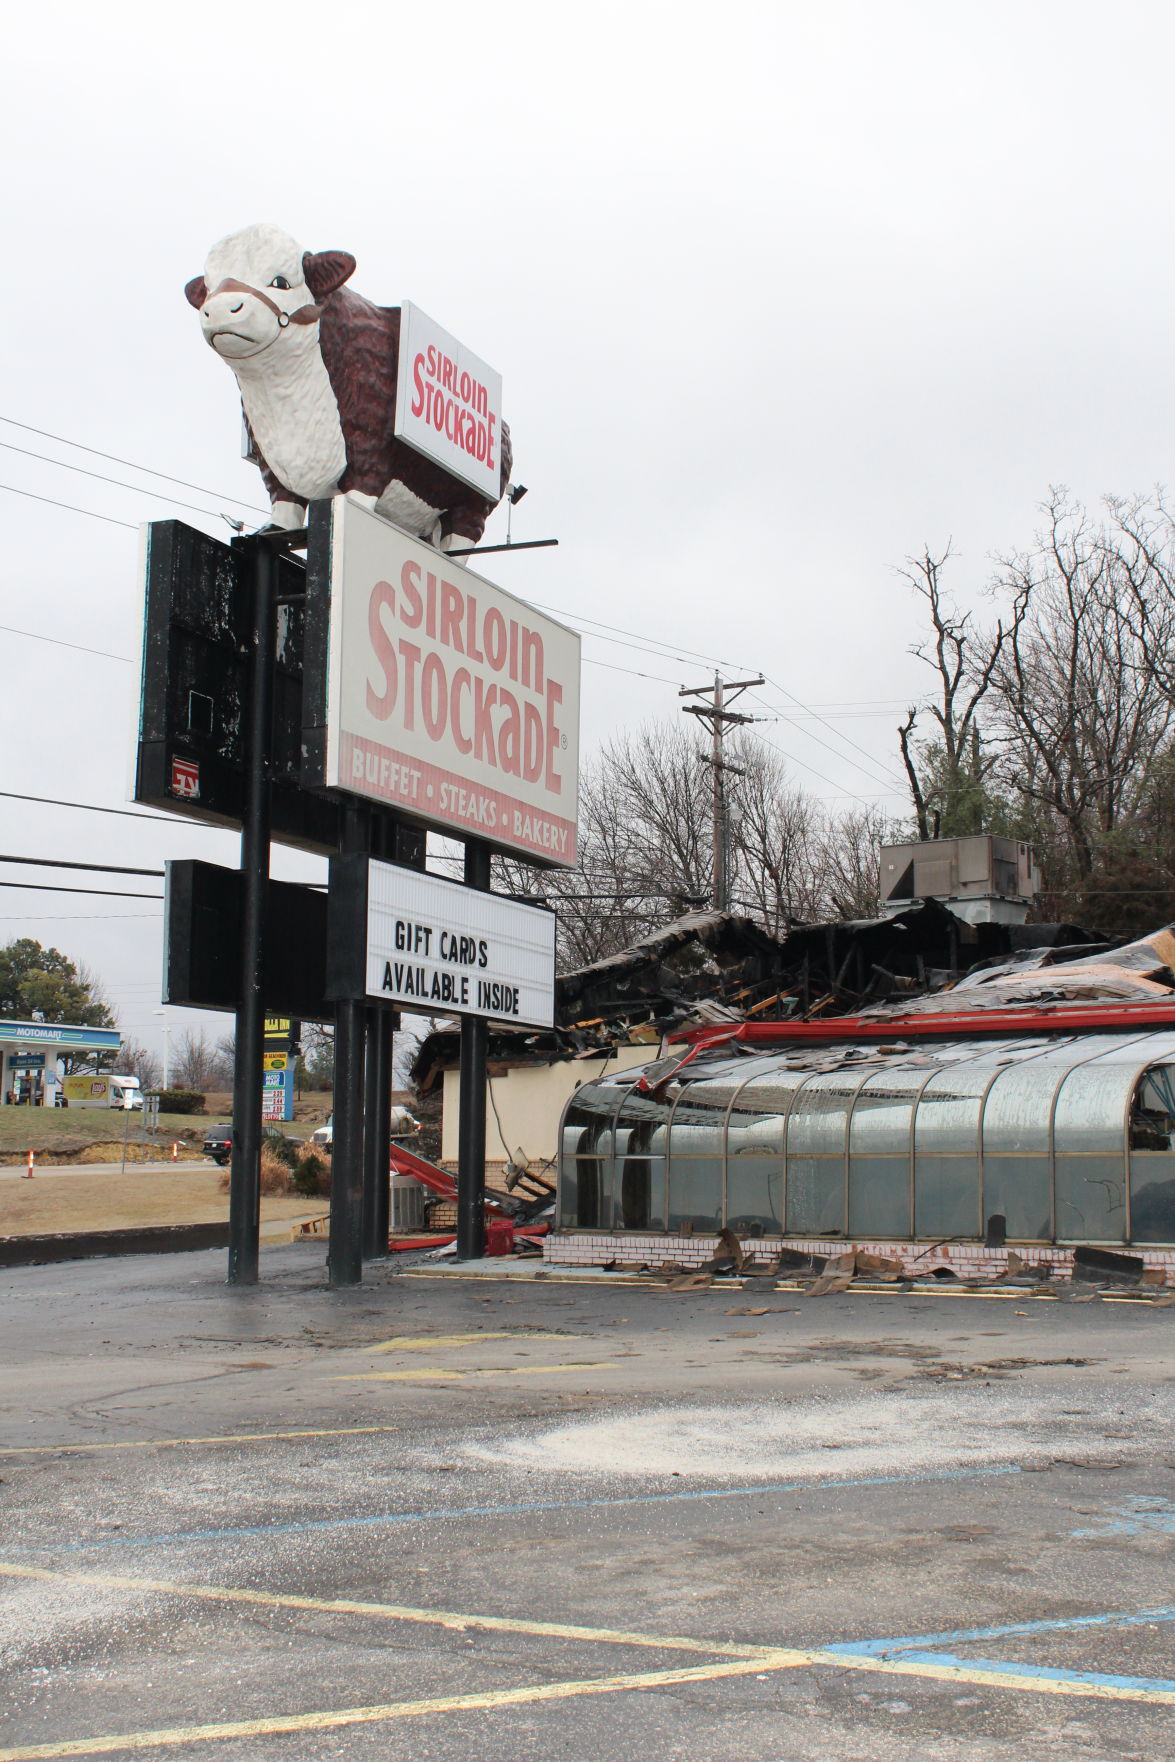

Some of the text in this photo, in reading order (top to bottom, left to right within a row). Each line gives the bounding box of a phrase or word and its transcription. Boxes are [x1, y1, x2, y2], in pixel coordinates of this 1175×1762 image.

[352, 747, 568, 854] BUFFET STEAKS BAKERY
[395, 920, 488, 968] GIFT CARDS
[382, 961, 519, 1015] AVAILABLE INSIDE
[16, 1027, 63, 1041] MOTOMART
